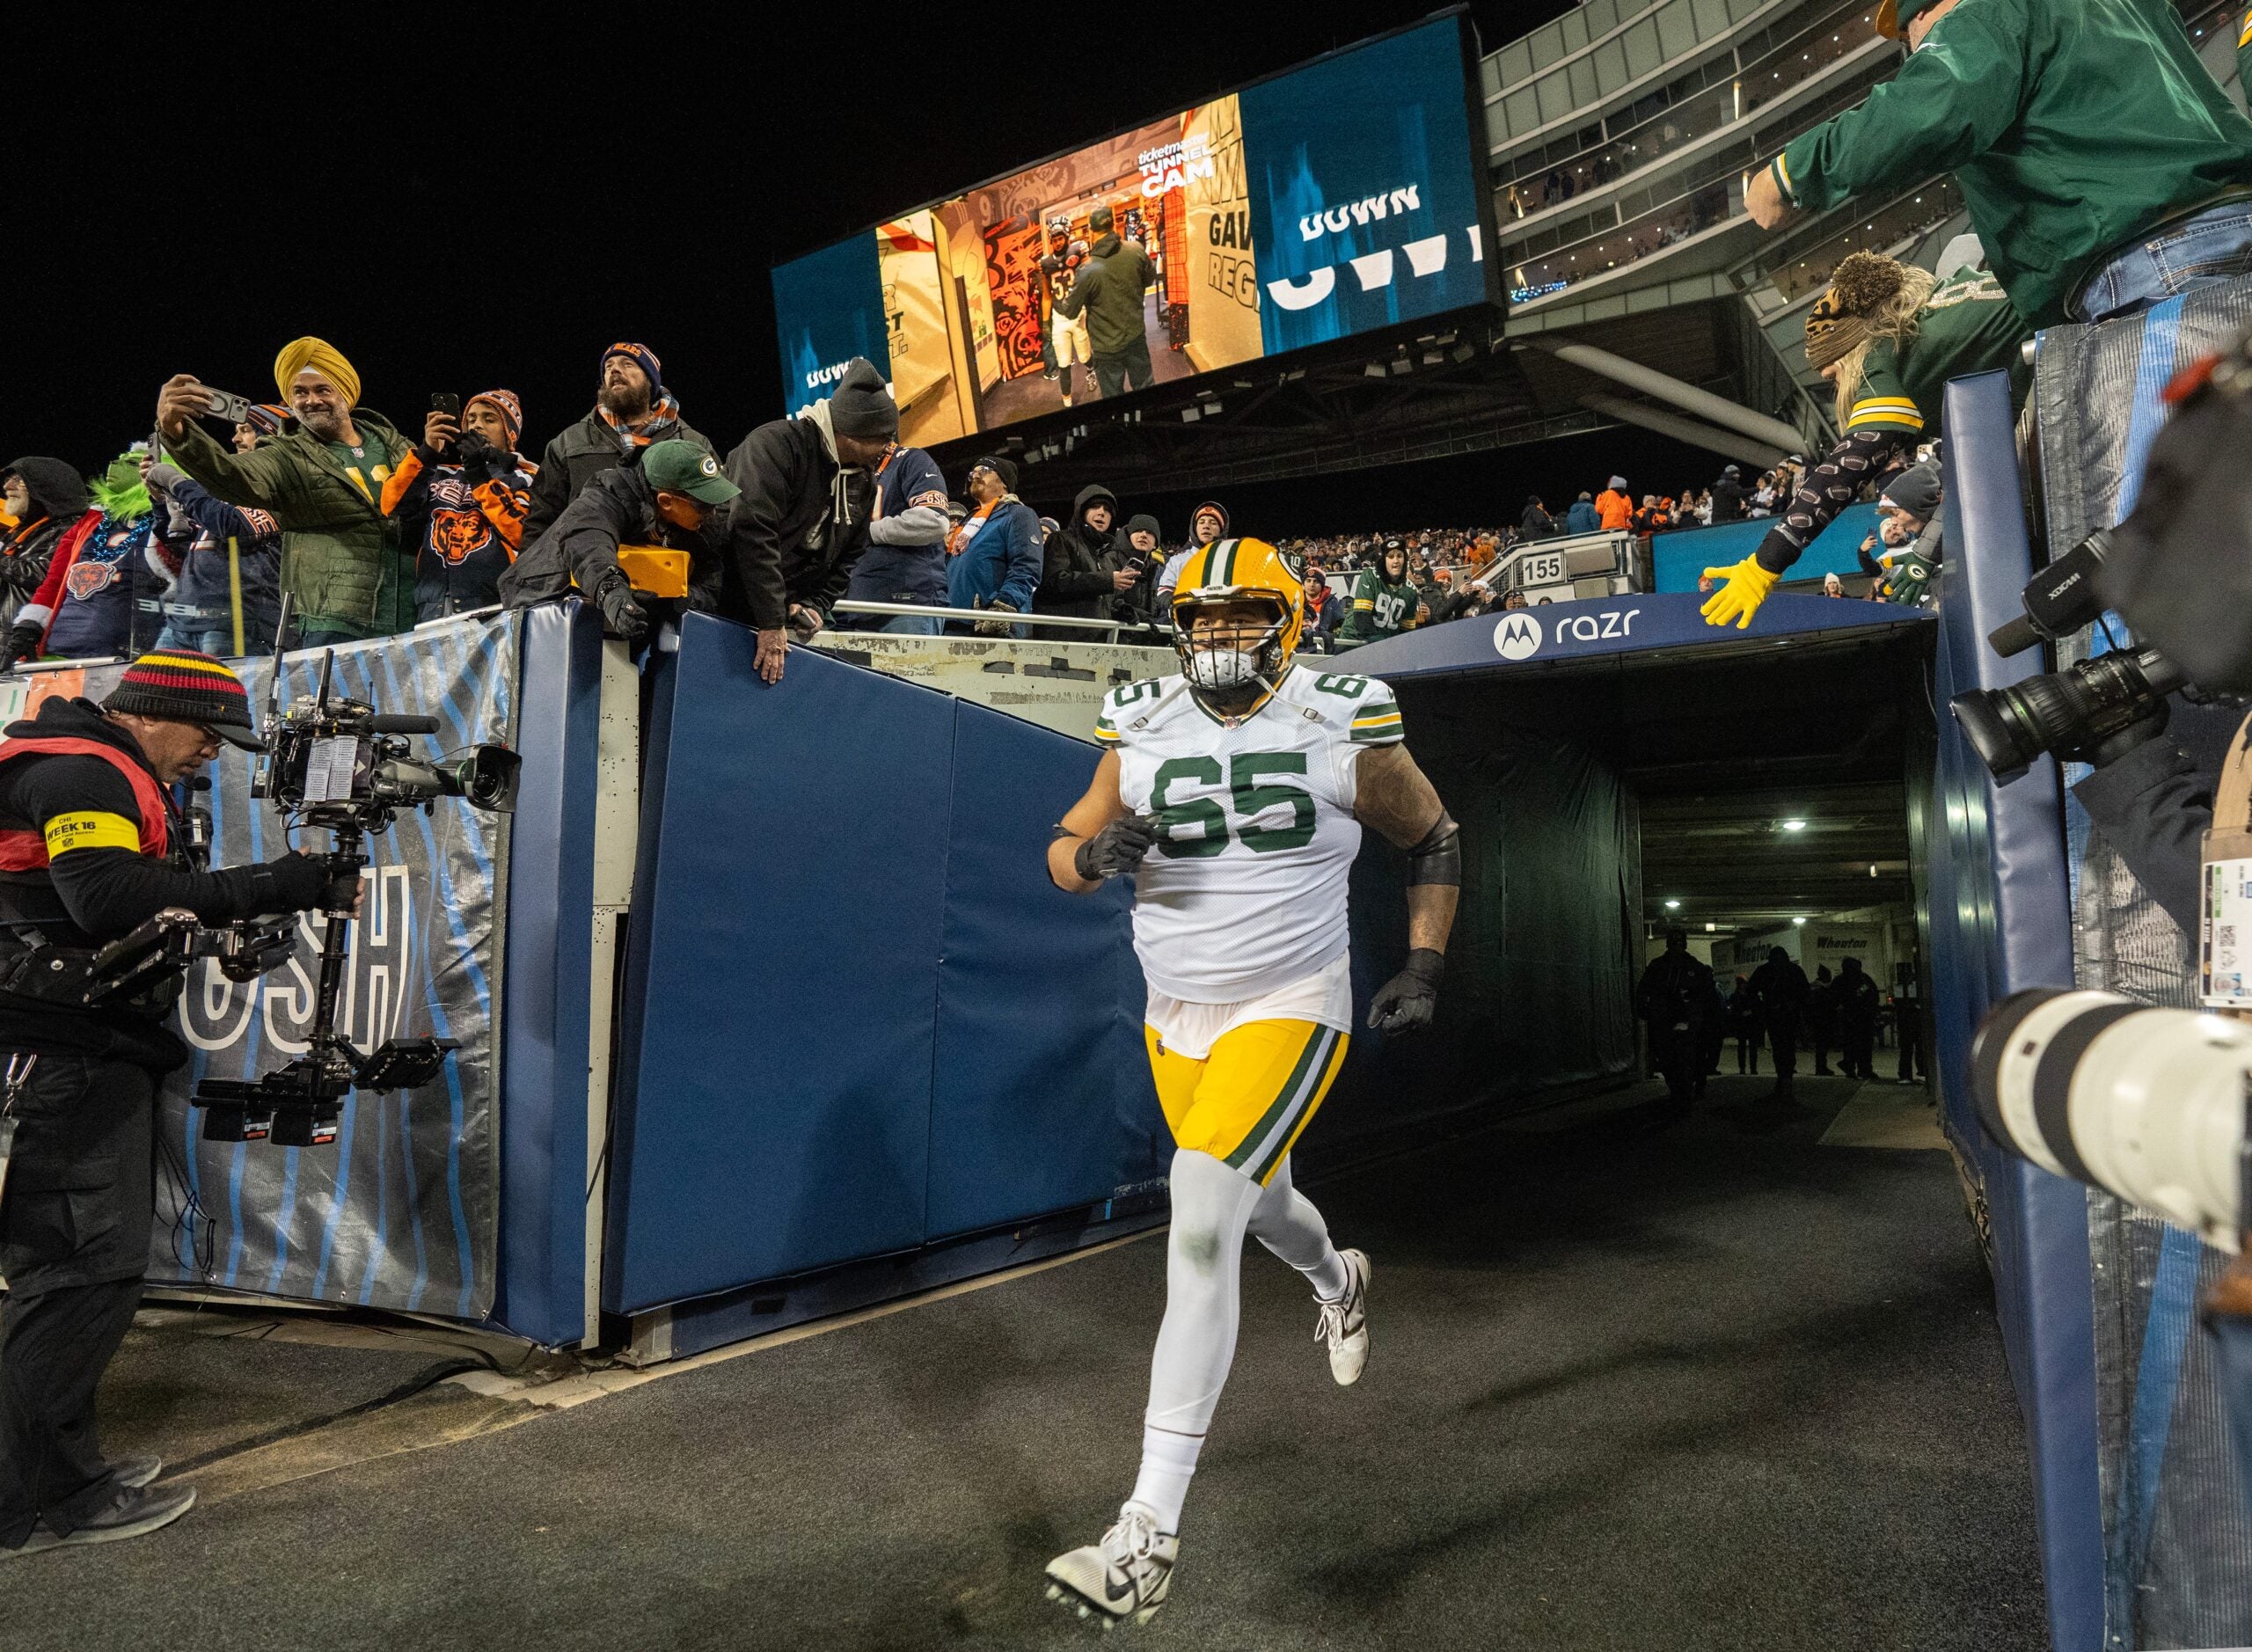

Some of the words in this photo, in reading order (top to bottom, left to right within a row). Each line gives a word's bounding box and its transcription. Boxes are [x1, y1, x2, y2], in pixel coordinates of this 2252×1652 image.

[1138, 133, 1210, 165] ticketmaster
[1141, 157, 1214, 198] CAM
[1208, 252, 1260, 312] REG
[1290, 555, 1301, 568] 10
[1524, 558, 1561, 581] 155
[1372, 592, 1407, 631] 90
[1556, 609, 1641, 644] razr
[1150, 752, 1317, 859] 65
[48, 822, 79, 841] WEEK
[81, 821, 97, 830] 16
[1817, 935, 1868, 949] Wheaton
